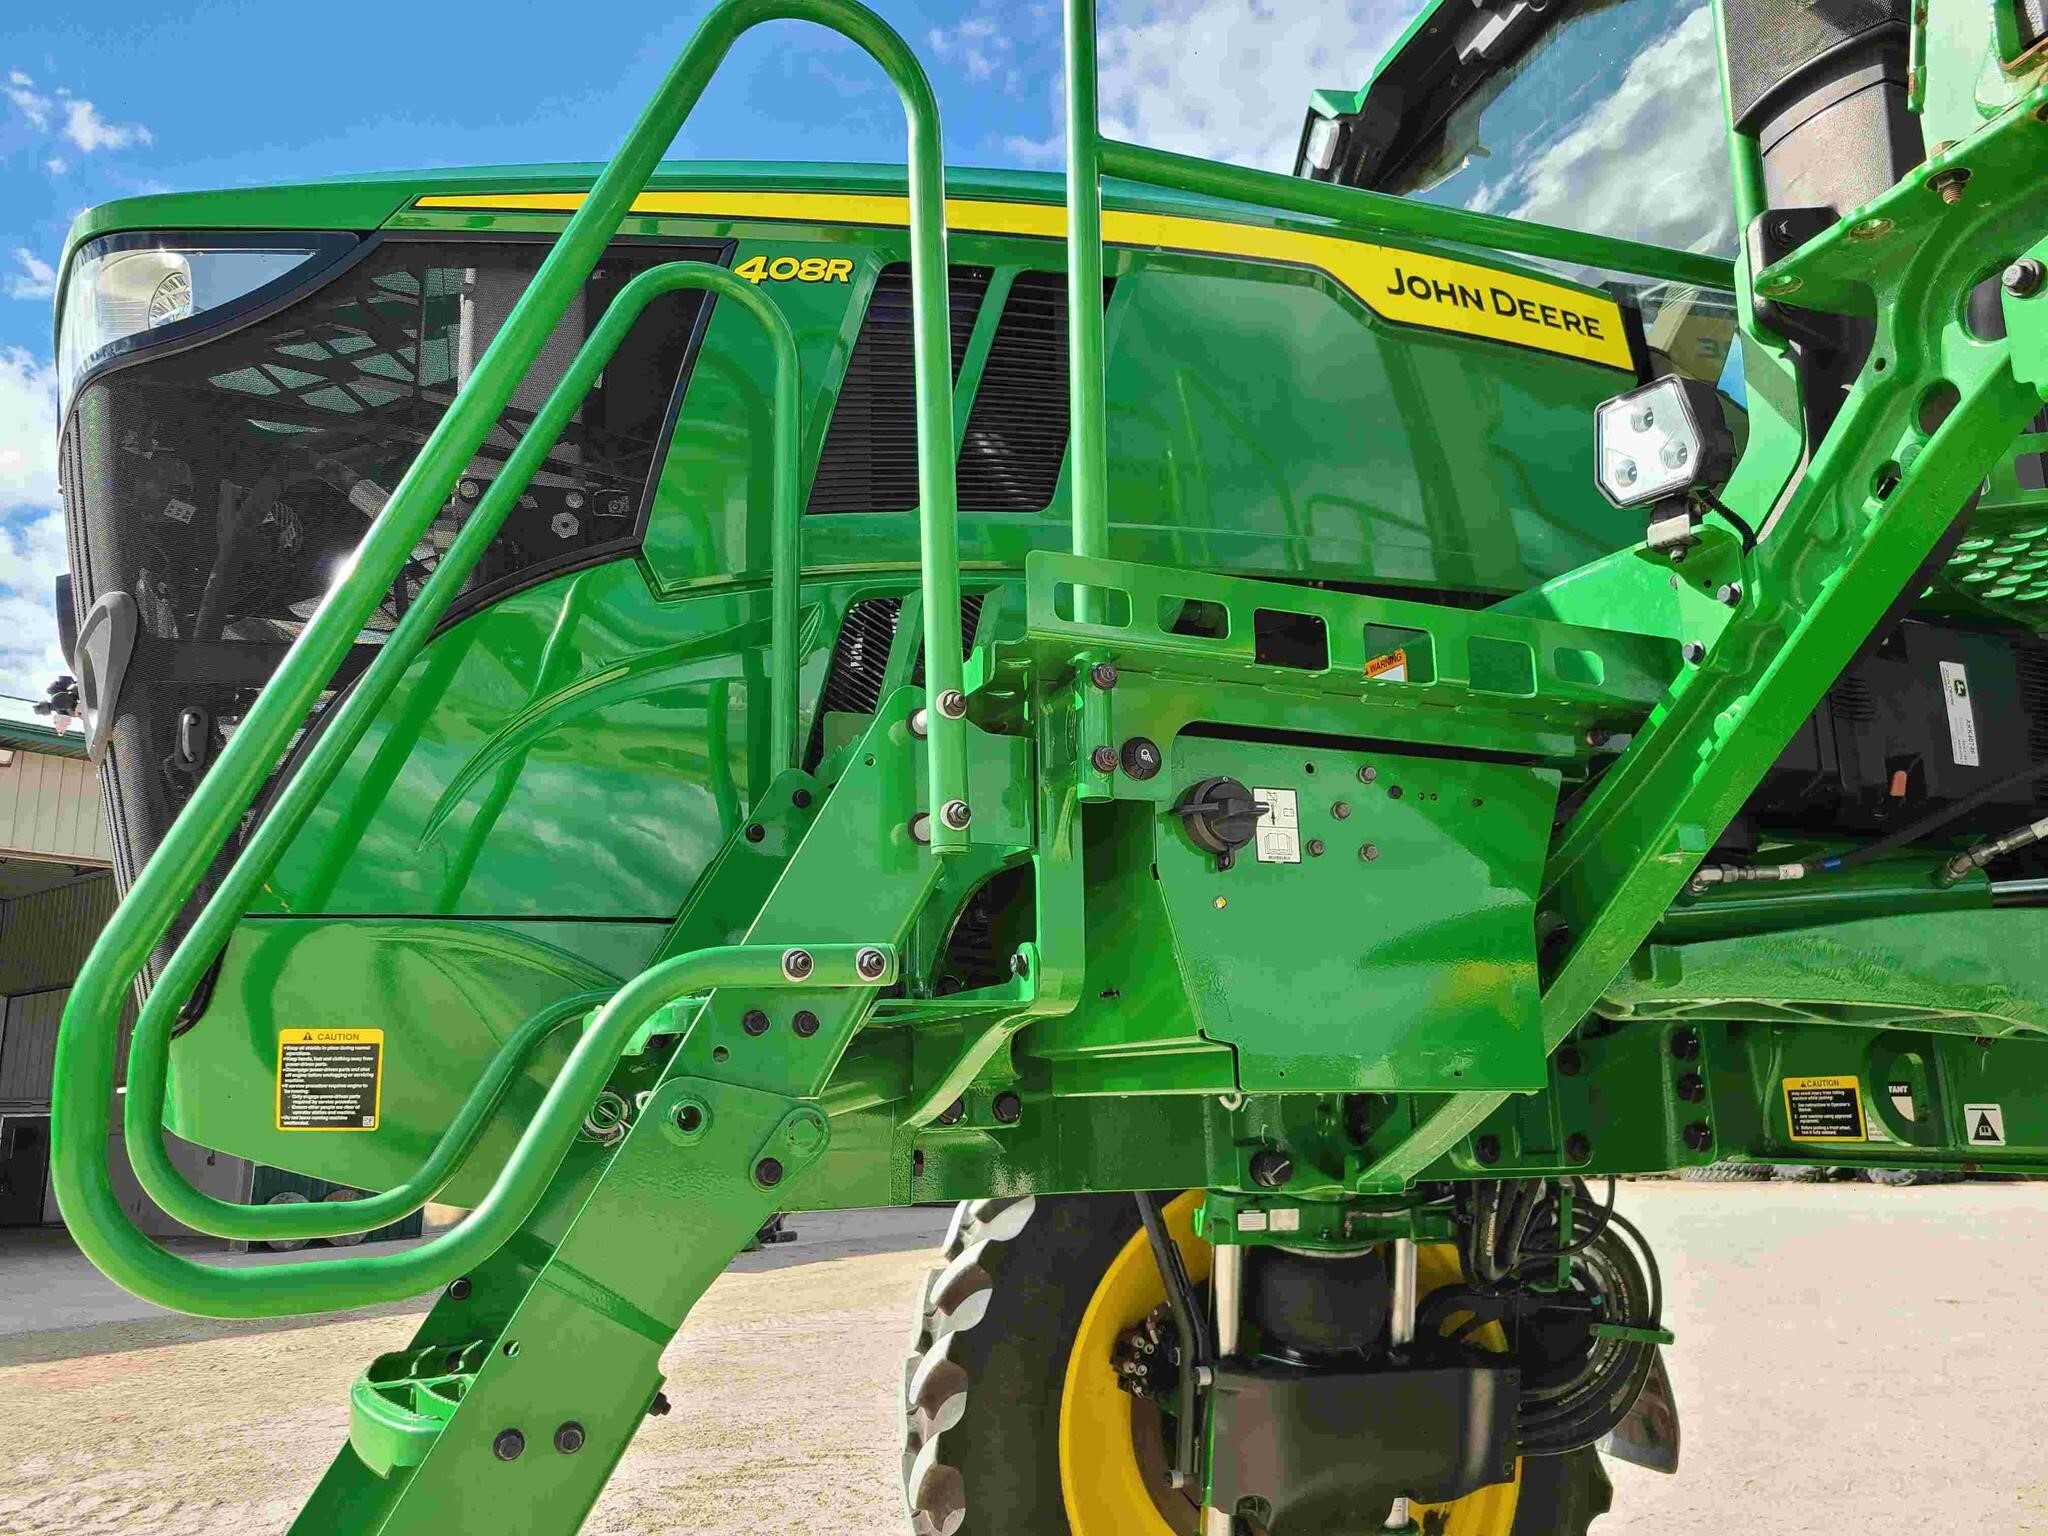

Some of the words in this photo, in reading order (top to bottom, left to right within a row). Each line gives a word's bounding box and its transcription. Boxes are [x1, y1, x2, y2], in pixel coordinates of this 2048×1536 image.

[734, 255, 854, 285] 408R
[1386, 267, 1485, 312] JOHN
[1489, 287, 1605, 341] DEERE
[1369, 652, 1402, 673] WARNING
[317, 1033, 360, 1041] CAUTION
[1807, 1079, 1840, 1088] CAUTION
